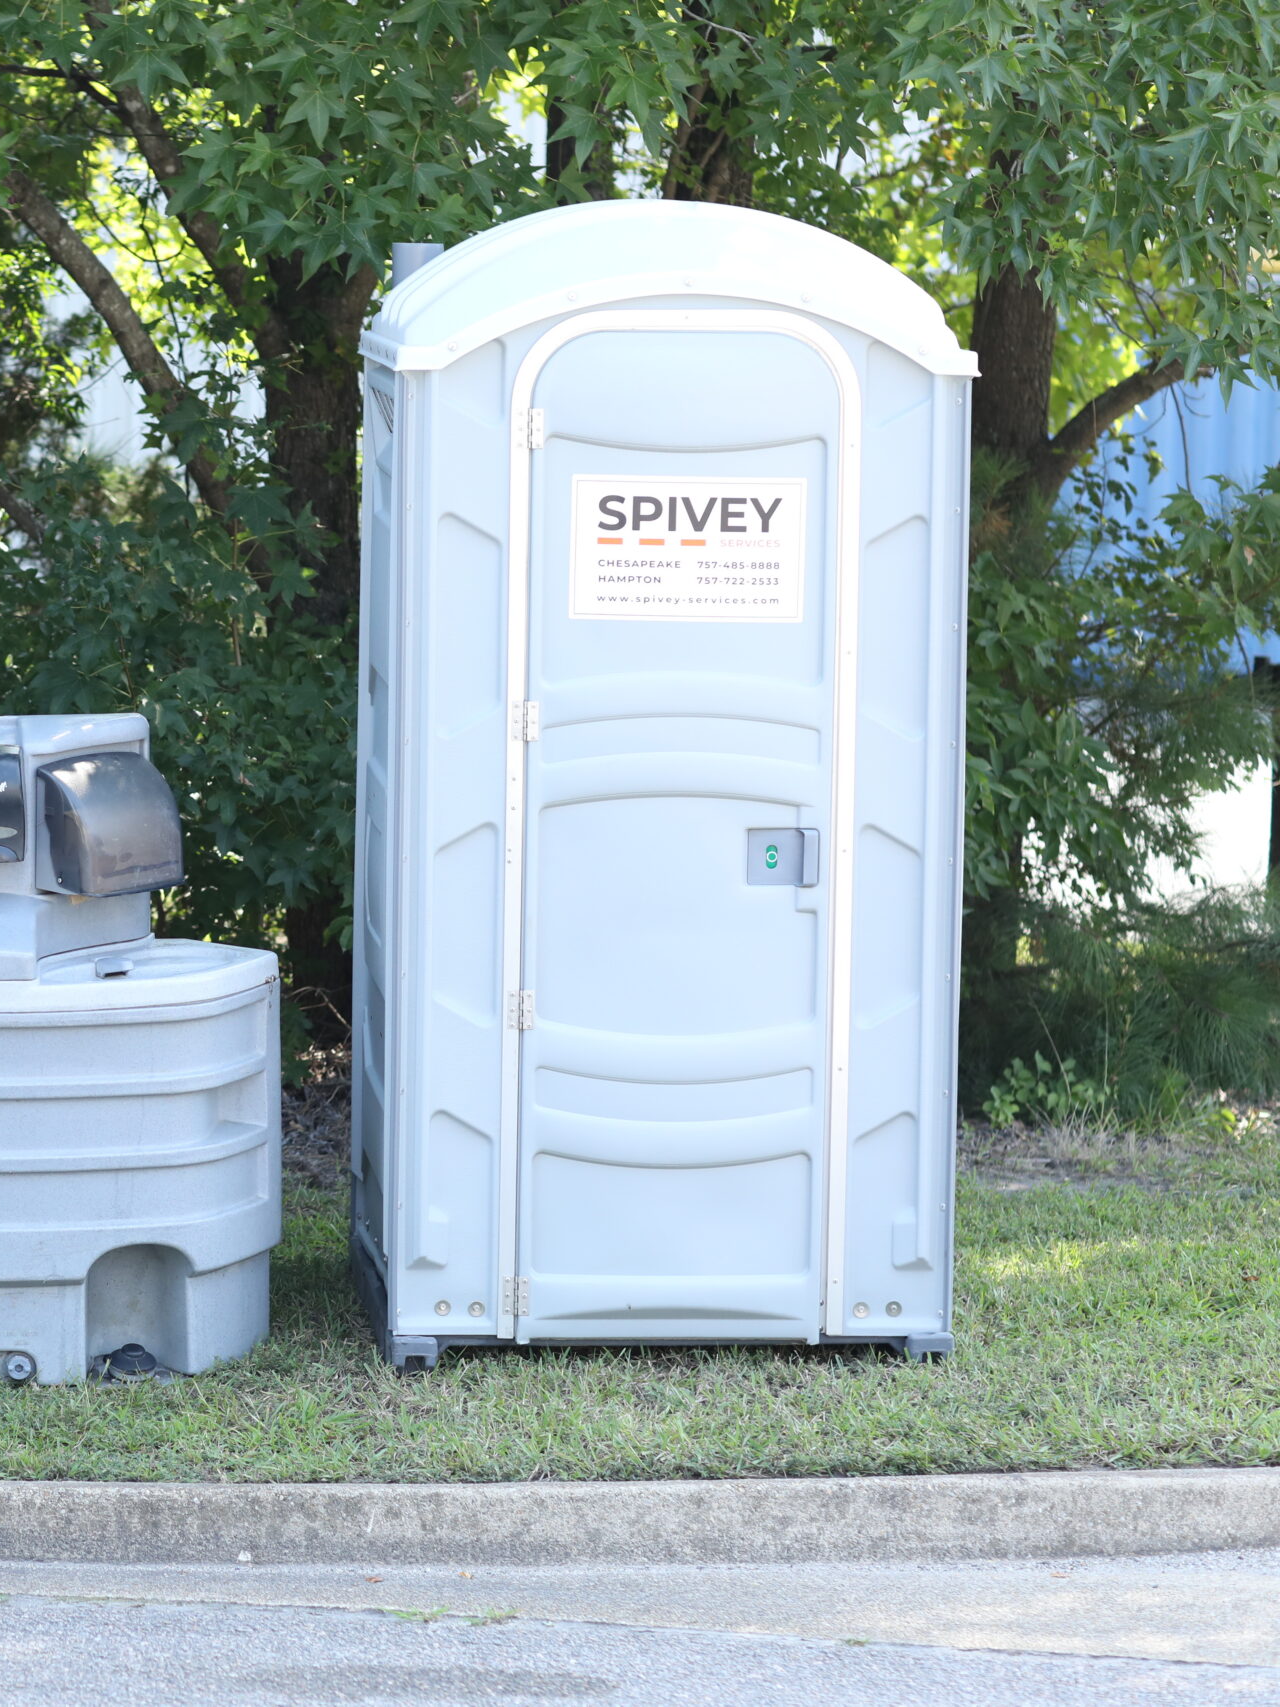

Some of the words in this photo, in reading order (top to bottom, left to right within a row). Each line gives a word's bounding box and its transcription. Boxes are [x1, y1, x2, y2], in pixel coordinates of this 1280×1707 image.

[597, 494, 783, 533] SPIVEY
[720, 538, 781, 548] SERVICES
[598, 559, 681, 569] CHESAPEAKE
[697, 560, 780, 570] 757-485-8888
[598, 575, 662, 584] HAMPTON
[696, 576, 780, 586] 757-722-2533
[596, 594, 780, 605] www.spivey-services.com
